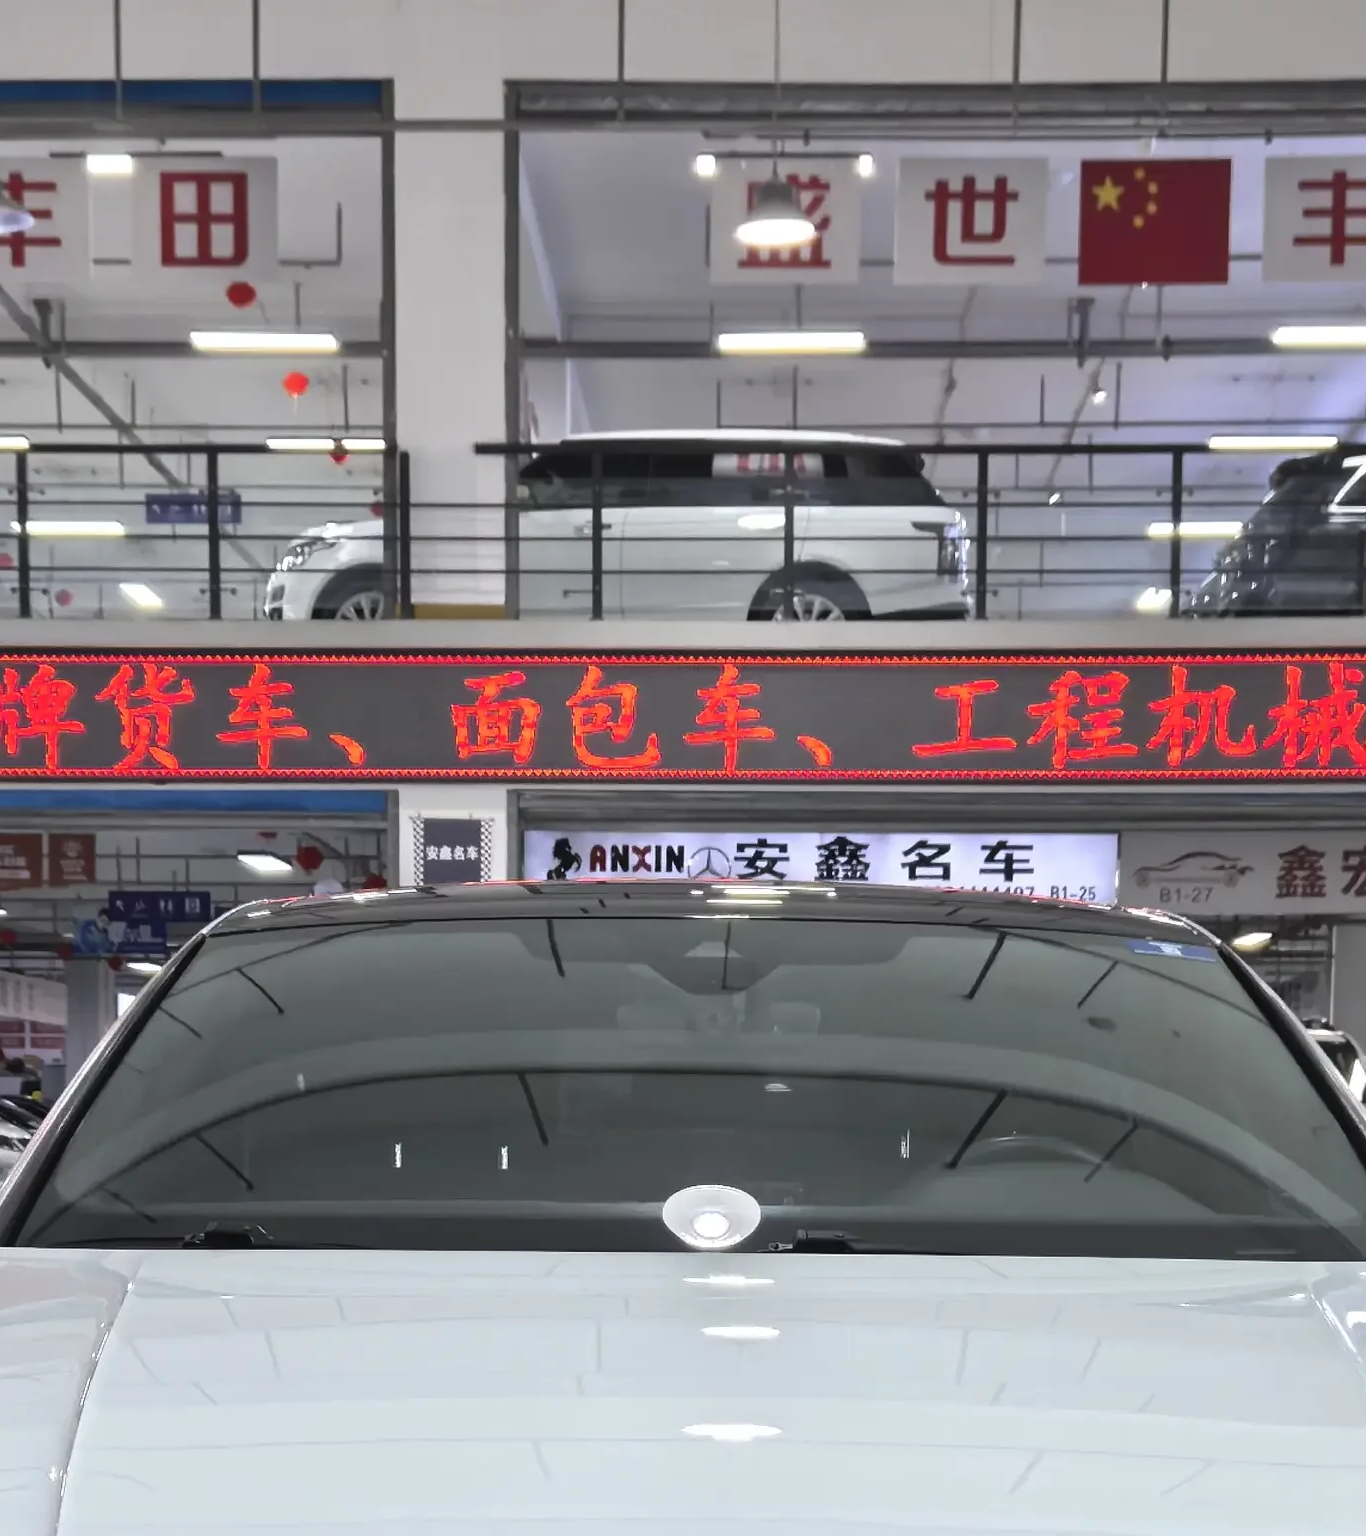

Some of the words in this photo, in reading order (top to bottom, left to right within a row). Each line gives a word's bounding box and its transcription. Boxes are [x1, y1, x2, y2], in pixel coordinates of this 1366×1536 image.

[426, 844, 479, 862] 安鑫名车
[589, 844, 684, 873] ANXIN
[733, 835, 1035, 883] 安鑫名车
[1159, 887, 1213, 903] B1-27
